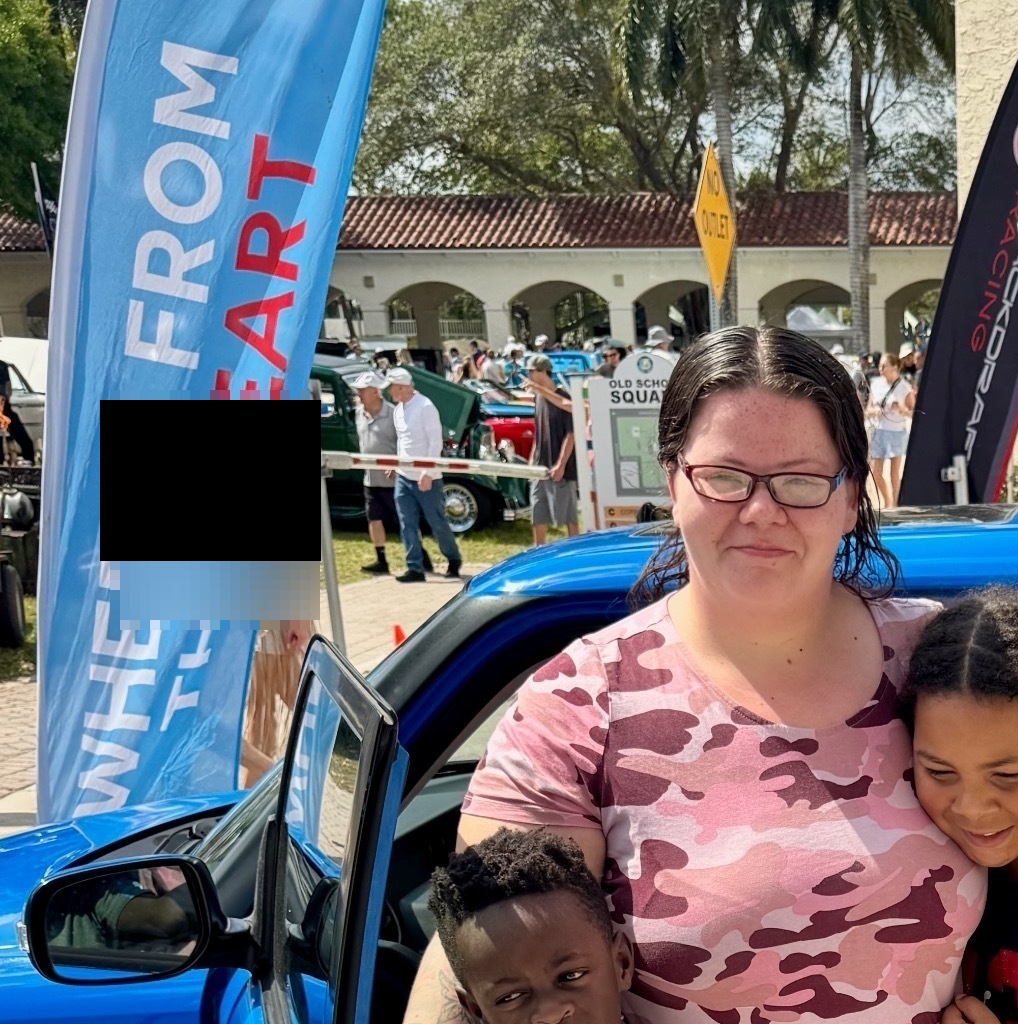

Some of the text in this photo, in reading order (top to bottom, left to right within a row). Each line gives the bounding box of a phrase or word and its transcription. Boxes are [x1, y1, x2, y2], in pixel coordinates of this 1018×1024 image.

[706, 170, 720, 197] NO
[124, 41, 239, 370] FROM
[701, 208, 730, 240] OUTLET
[609, 379, 669, 389] OLD SCHO
[611, 390, 660, 404] SQUA
